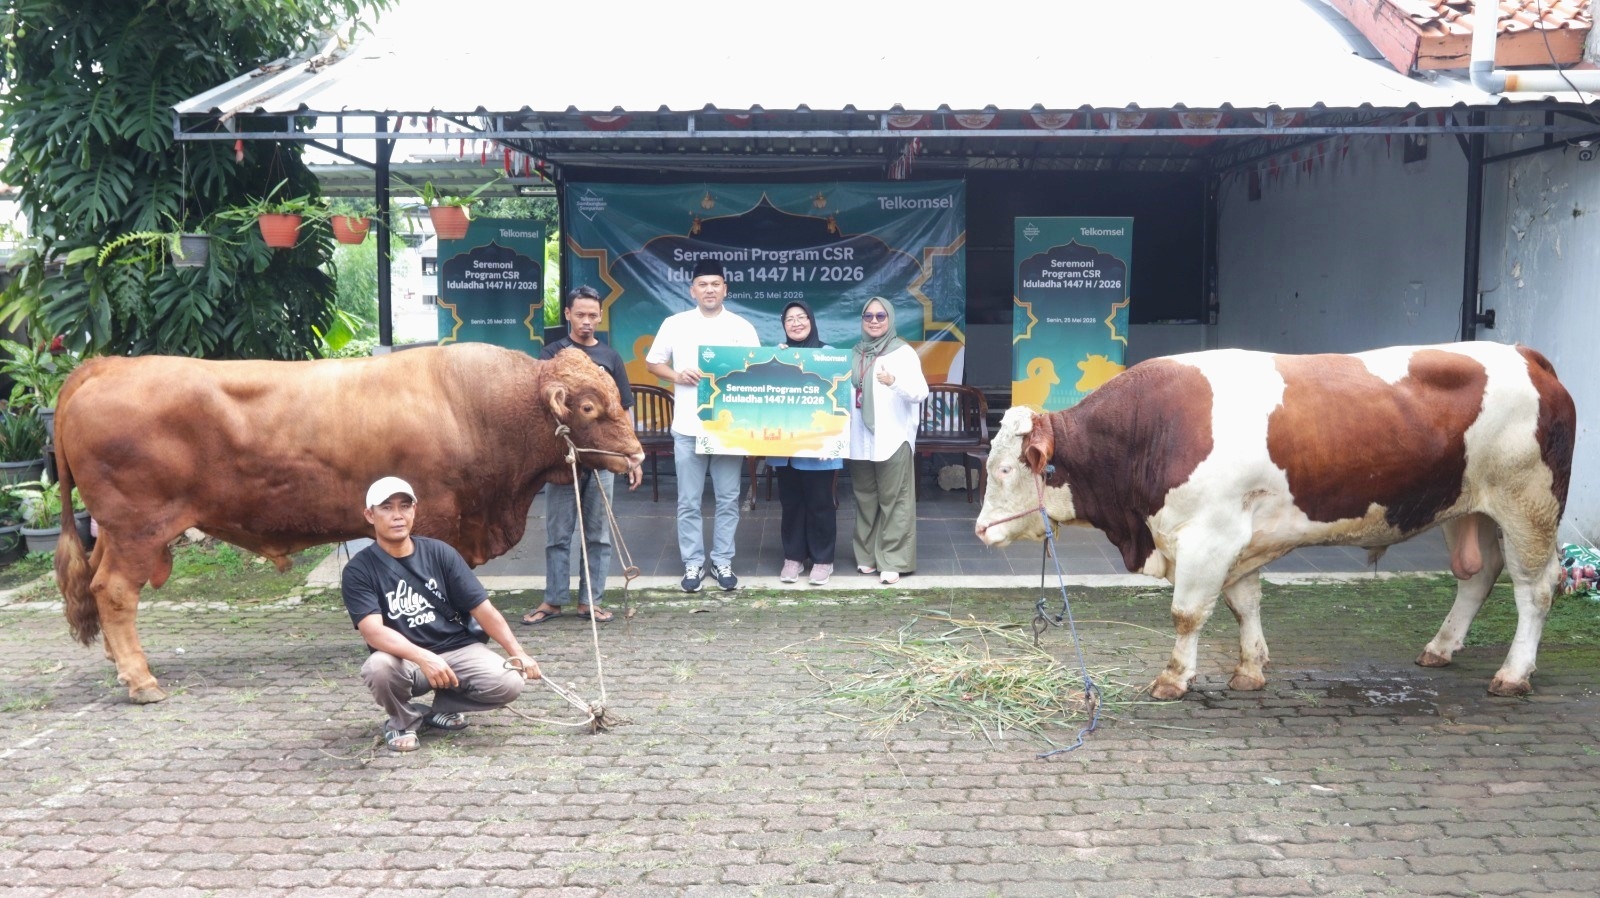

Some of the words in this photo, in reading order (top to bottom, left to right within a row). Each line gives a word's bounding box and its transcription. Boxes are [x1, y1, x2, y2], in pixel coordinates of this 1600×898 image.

[877, 196, 953, 210] Telkomsel
[499, 228, 539, 238] Telkomsel
[1080, 228, 1124, 236] Telkomsel
[673, 248, 748, 262] Seremoni
[751, 248, 820, 264] Program
[822, 247, 854, 261] CSR
[473, 260, 514, 269] Seremoni
[1050, 260, 1094, 268] Seremoni
[465, 270, 501, 280] Program
[502, 271, 520, 280] CSR
[668, 266, 744, 282] Iduha
[748, 266, 788, 282] 1447
[792, 266, 806, 282] H
[809, 266, 817, 282] /
[820, 266, 864, 282] 2026
[1042, 270, 1081, 280] Program
[1082, 270, 1101, 278] CSR
[446, 280, 484, 289] Iduladha
[512, 282, 517, 290] /
[518, 282, 538, 290] 2026
[1023, 280, 1062, 288] Iduladha
[1064, 280, 1082, 288] 1447
[1085, 280, 1092, 288] H
[1094, 280, 1098, 288] /
[1099, 280, 1121, 288] 2026
[728, 291, 752, 300] Senin,
[766, 291, 782, 299] Mei
[783, 291, 804, 299] 2026
[812, 354, 848, 362] Telkomsel
[726, 384, 766, 393] Seremoni
[766, 385, 802, 394] Program
[803, 386, 820, 394] CSR
[722, 394, 763, 403] Iduladha
[764, 395, 785, 404] 1447
[787, 396, 794, 404] H
[796, 396, 800, 404] /
[801, 396, 824, 405] 2026
[406, 611, 436, 628] 2026
